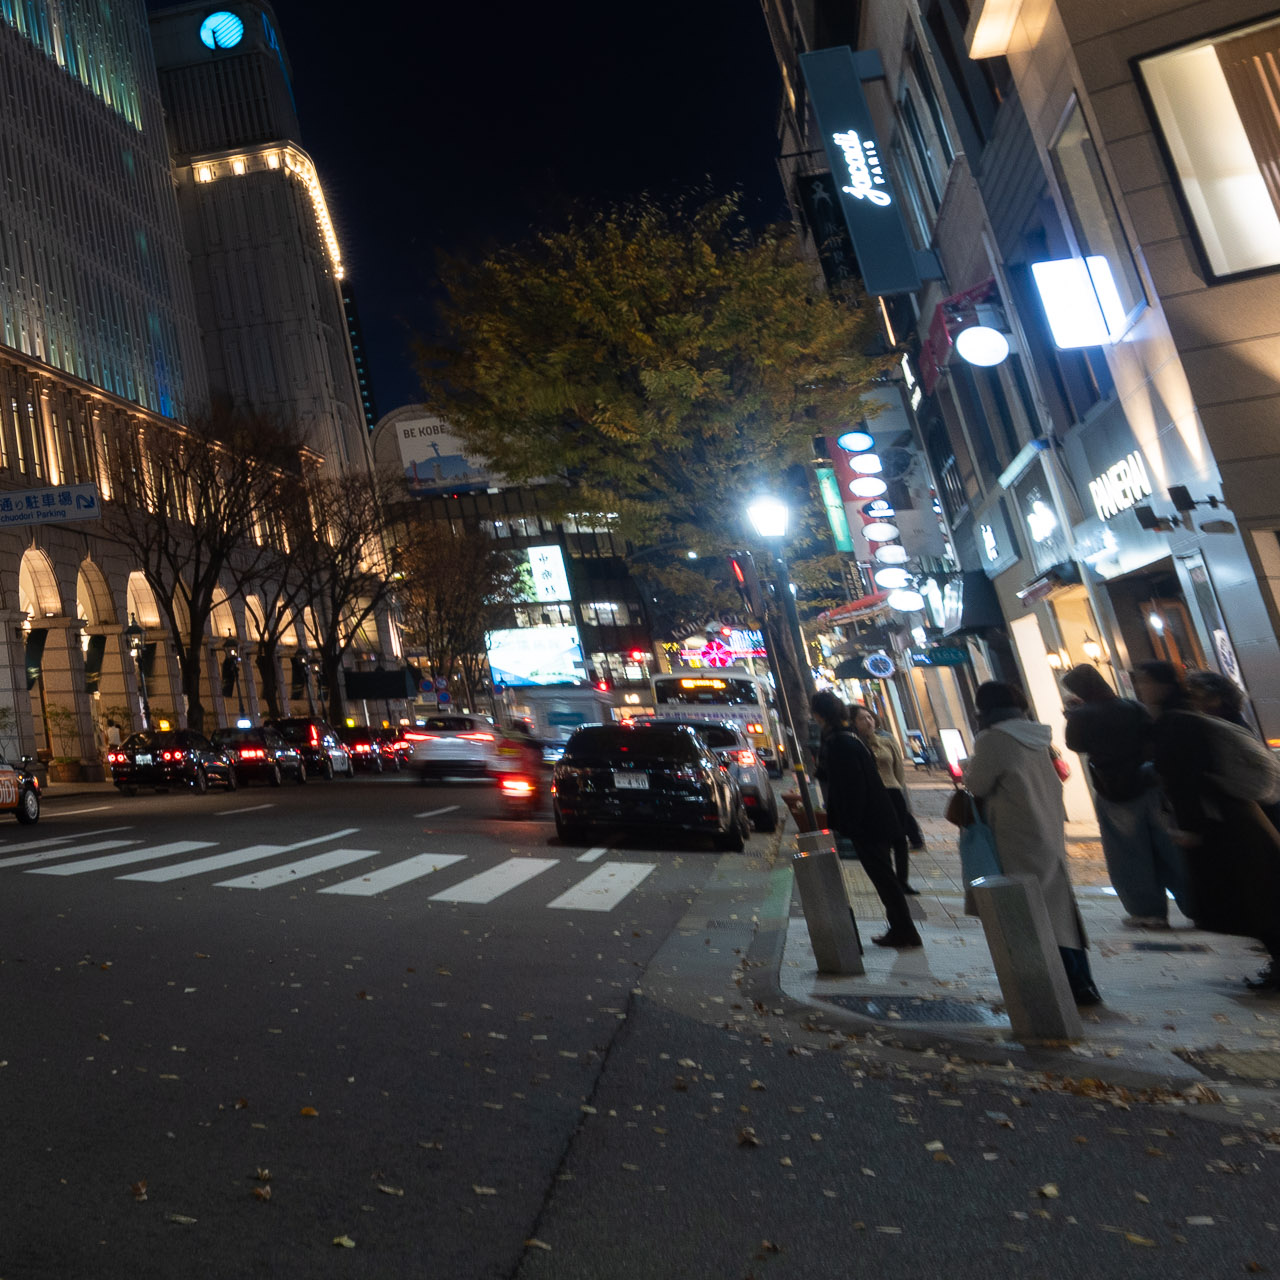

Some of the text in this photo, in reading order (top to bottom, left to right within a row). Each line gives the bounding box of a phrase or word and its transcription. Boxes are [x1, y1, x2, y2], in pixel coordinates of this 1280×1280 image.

[863, 140, 886, 185] PARIS
[403, 424, 446, 439] BE KOBE
[1088, 450, 1153, 522] PANERAI
[37, 509, 67, 519] Parking
